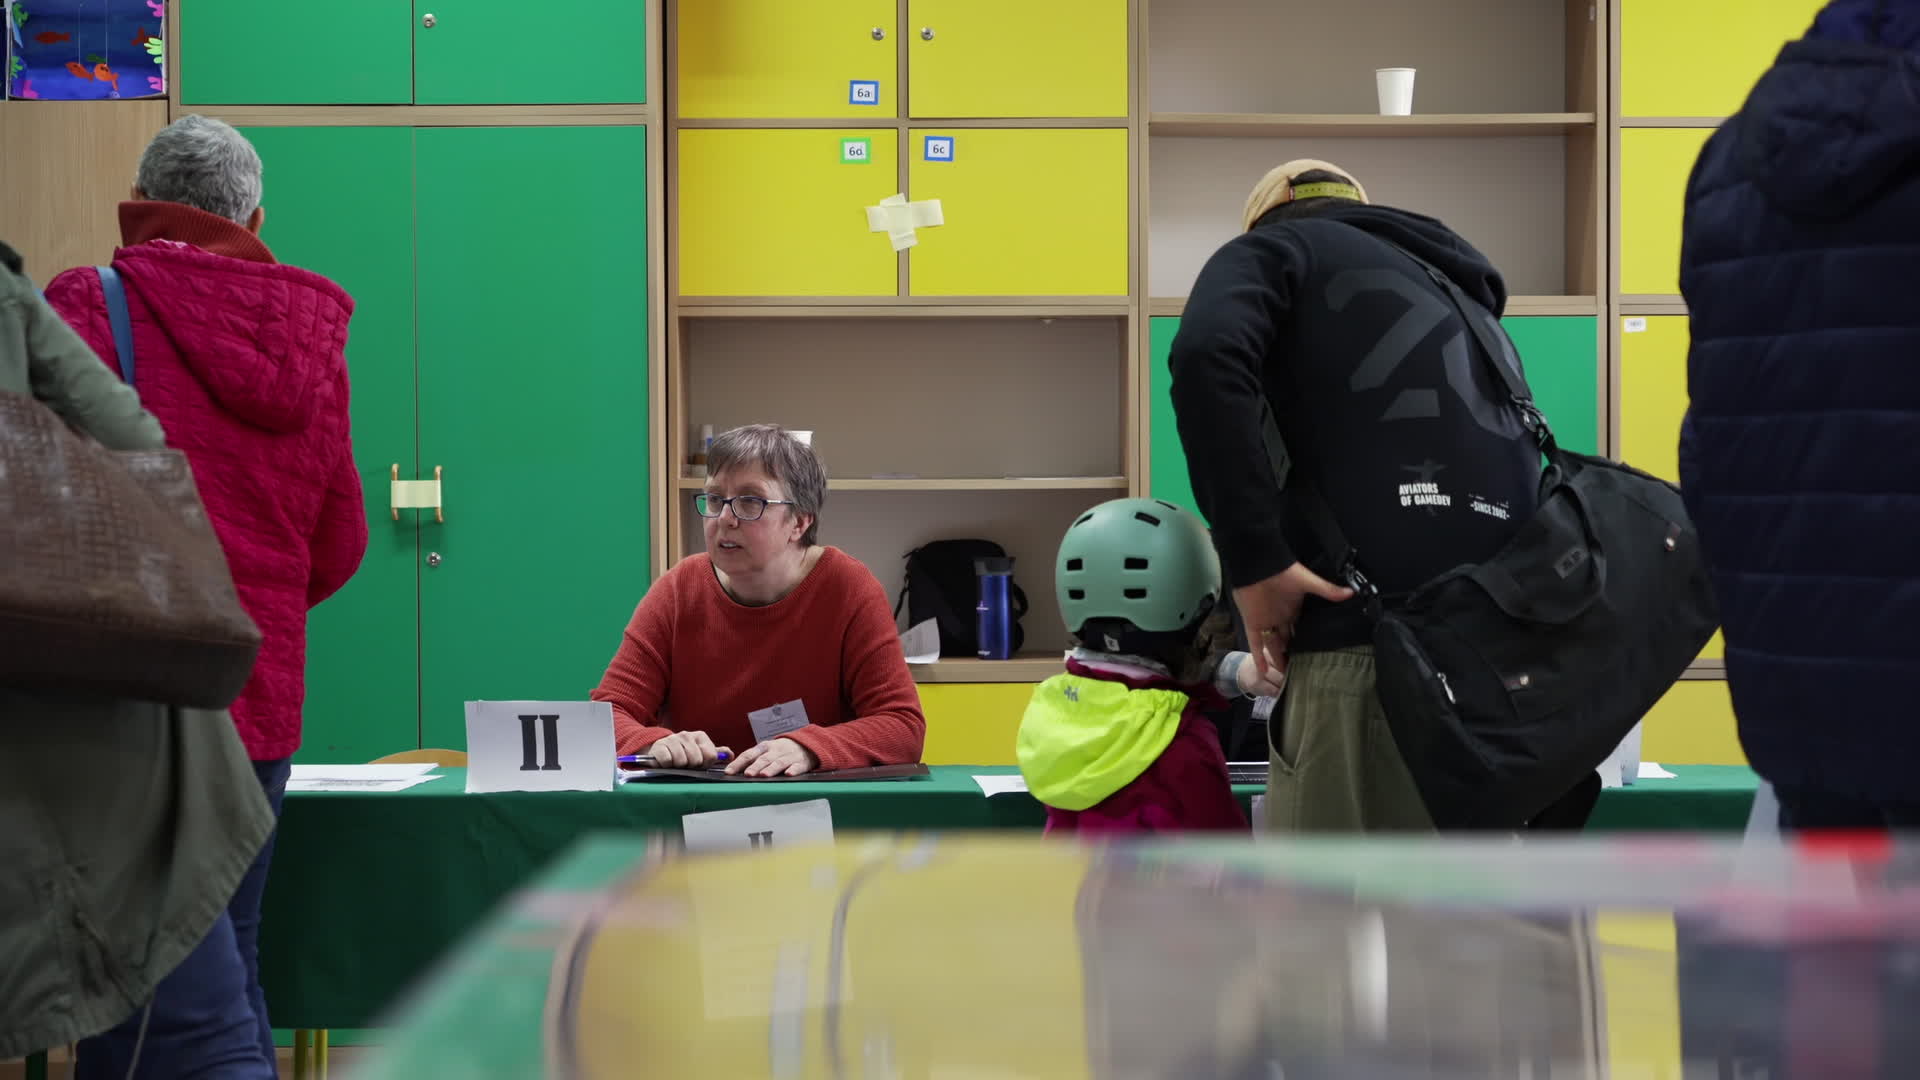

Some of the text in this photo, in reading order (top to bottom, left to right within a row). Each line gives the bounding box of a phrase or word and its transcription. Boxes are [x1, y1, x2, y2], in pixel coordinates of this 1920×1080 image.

[857, 88, 870, 98] 6a
[932, 144, 945, 154] 6c
[1399, 482, 1439, 496] AVIATORS
[1400, 494, 1451, 507] OF GAMEDEV
[518, 714, 562, 771] II
